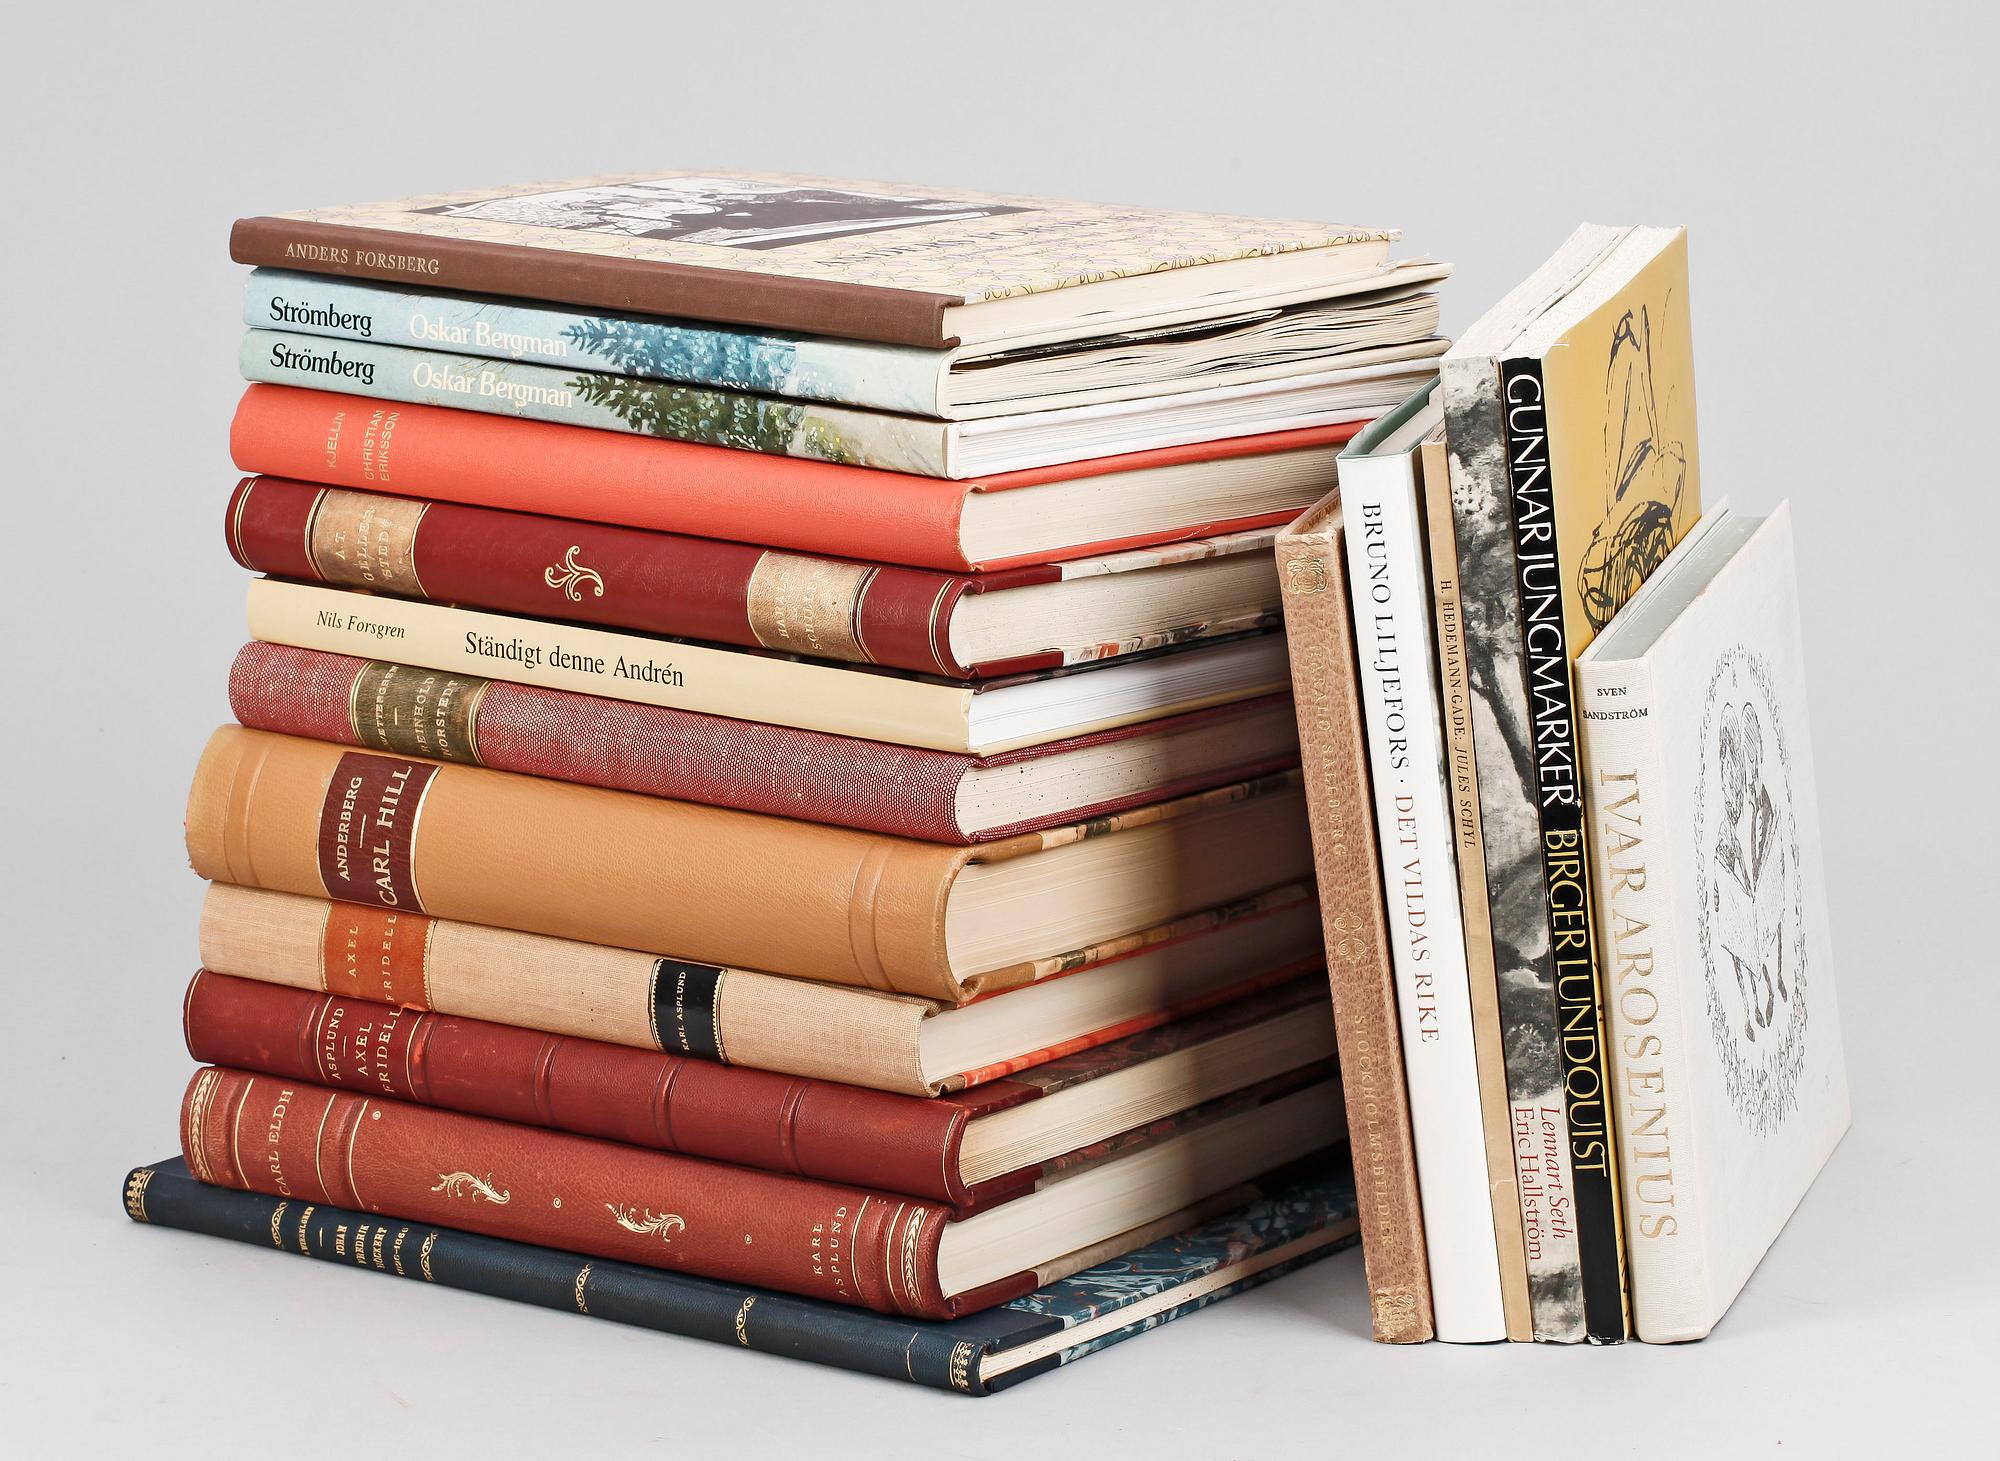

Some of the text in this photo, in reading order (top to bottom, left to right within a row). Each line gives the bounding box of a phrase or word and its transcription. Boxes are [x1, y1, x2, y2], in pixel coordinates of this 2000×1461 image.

[285, 242, 441, 275] ANDERS FORSBERG
[269, 296, 373, 337] Strömberg
[410, 314, 568, 358] Oskar Bergman
[270, 343, 375, 385] Strömberg
[412, 362, 574, 408] Oskar Bergman
[326, 411, 345, 468] KJELLIN
[363, 409, 385, 480] CHRISTIAN
[377, 411, 401, 481] ERIKSSON
[316, 610, 406, 640] Nils Forsgren
[1506, 374, 1575, 808] GUNNAR JUNGMARKER
[465, 631, 685, 687] Ständigt denne Andrén
[1597, 687, 1627, 697] SVEN
[414, 677, 436, 753] REINHOLD
[436, 680, 459, 757] NORSTEDT
[1441, 580, 1476, 849] H. HEDEMANN-GADE: JULES SCHYL
[1582, 707, 1649, 720] SANDSTRÖM
[1362, 502, 1440, 1043] BRUNO LILJEFORS DET VILDAS RIKE
[335, 775, 363, 882] ANDERBERG
[372, 765, 413, 906] CARL HILL
[348, 925, 360, 978] AXEL
[382, 914, 398, 1003] FRIDELL
[676, 971, 690, 1051] KARL ASPLUND
[1545, 829, 1607, 1178] BIRGER LUNDQUIST
[1600, 768, 1678, 1240] IVAR AROSENIUS
[325, 1007, 345, 1080] ASPLUND
[355, 1021, 373, 1076] AXEL
[376, 1009, 402, 1092] FRIDELL
[269, 1089, 295, 1196] CARL ELDH
[1540, 1107, 1574, 1240] Lennart Seth
[1514, 1106, 1545, 1261] Eric Hallström
[336, 1224, 348, 1256] JOHAN
[354, 1224, 370, 1265] FREDRIK
[373, 1226, 388, 1270] HÖCKERT
[830, 1206, 850, 1297] ASPLUND
